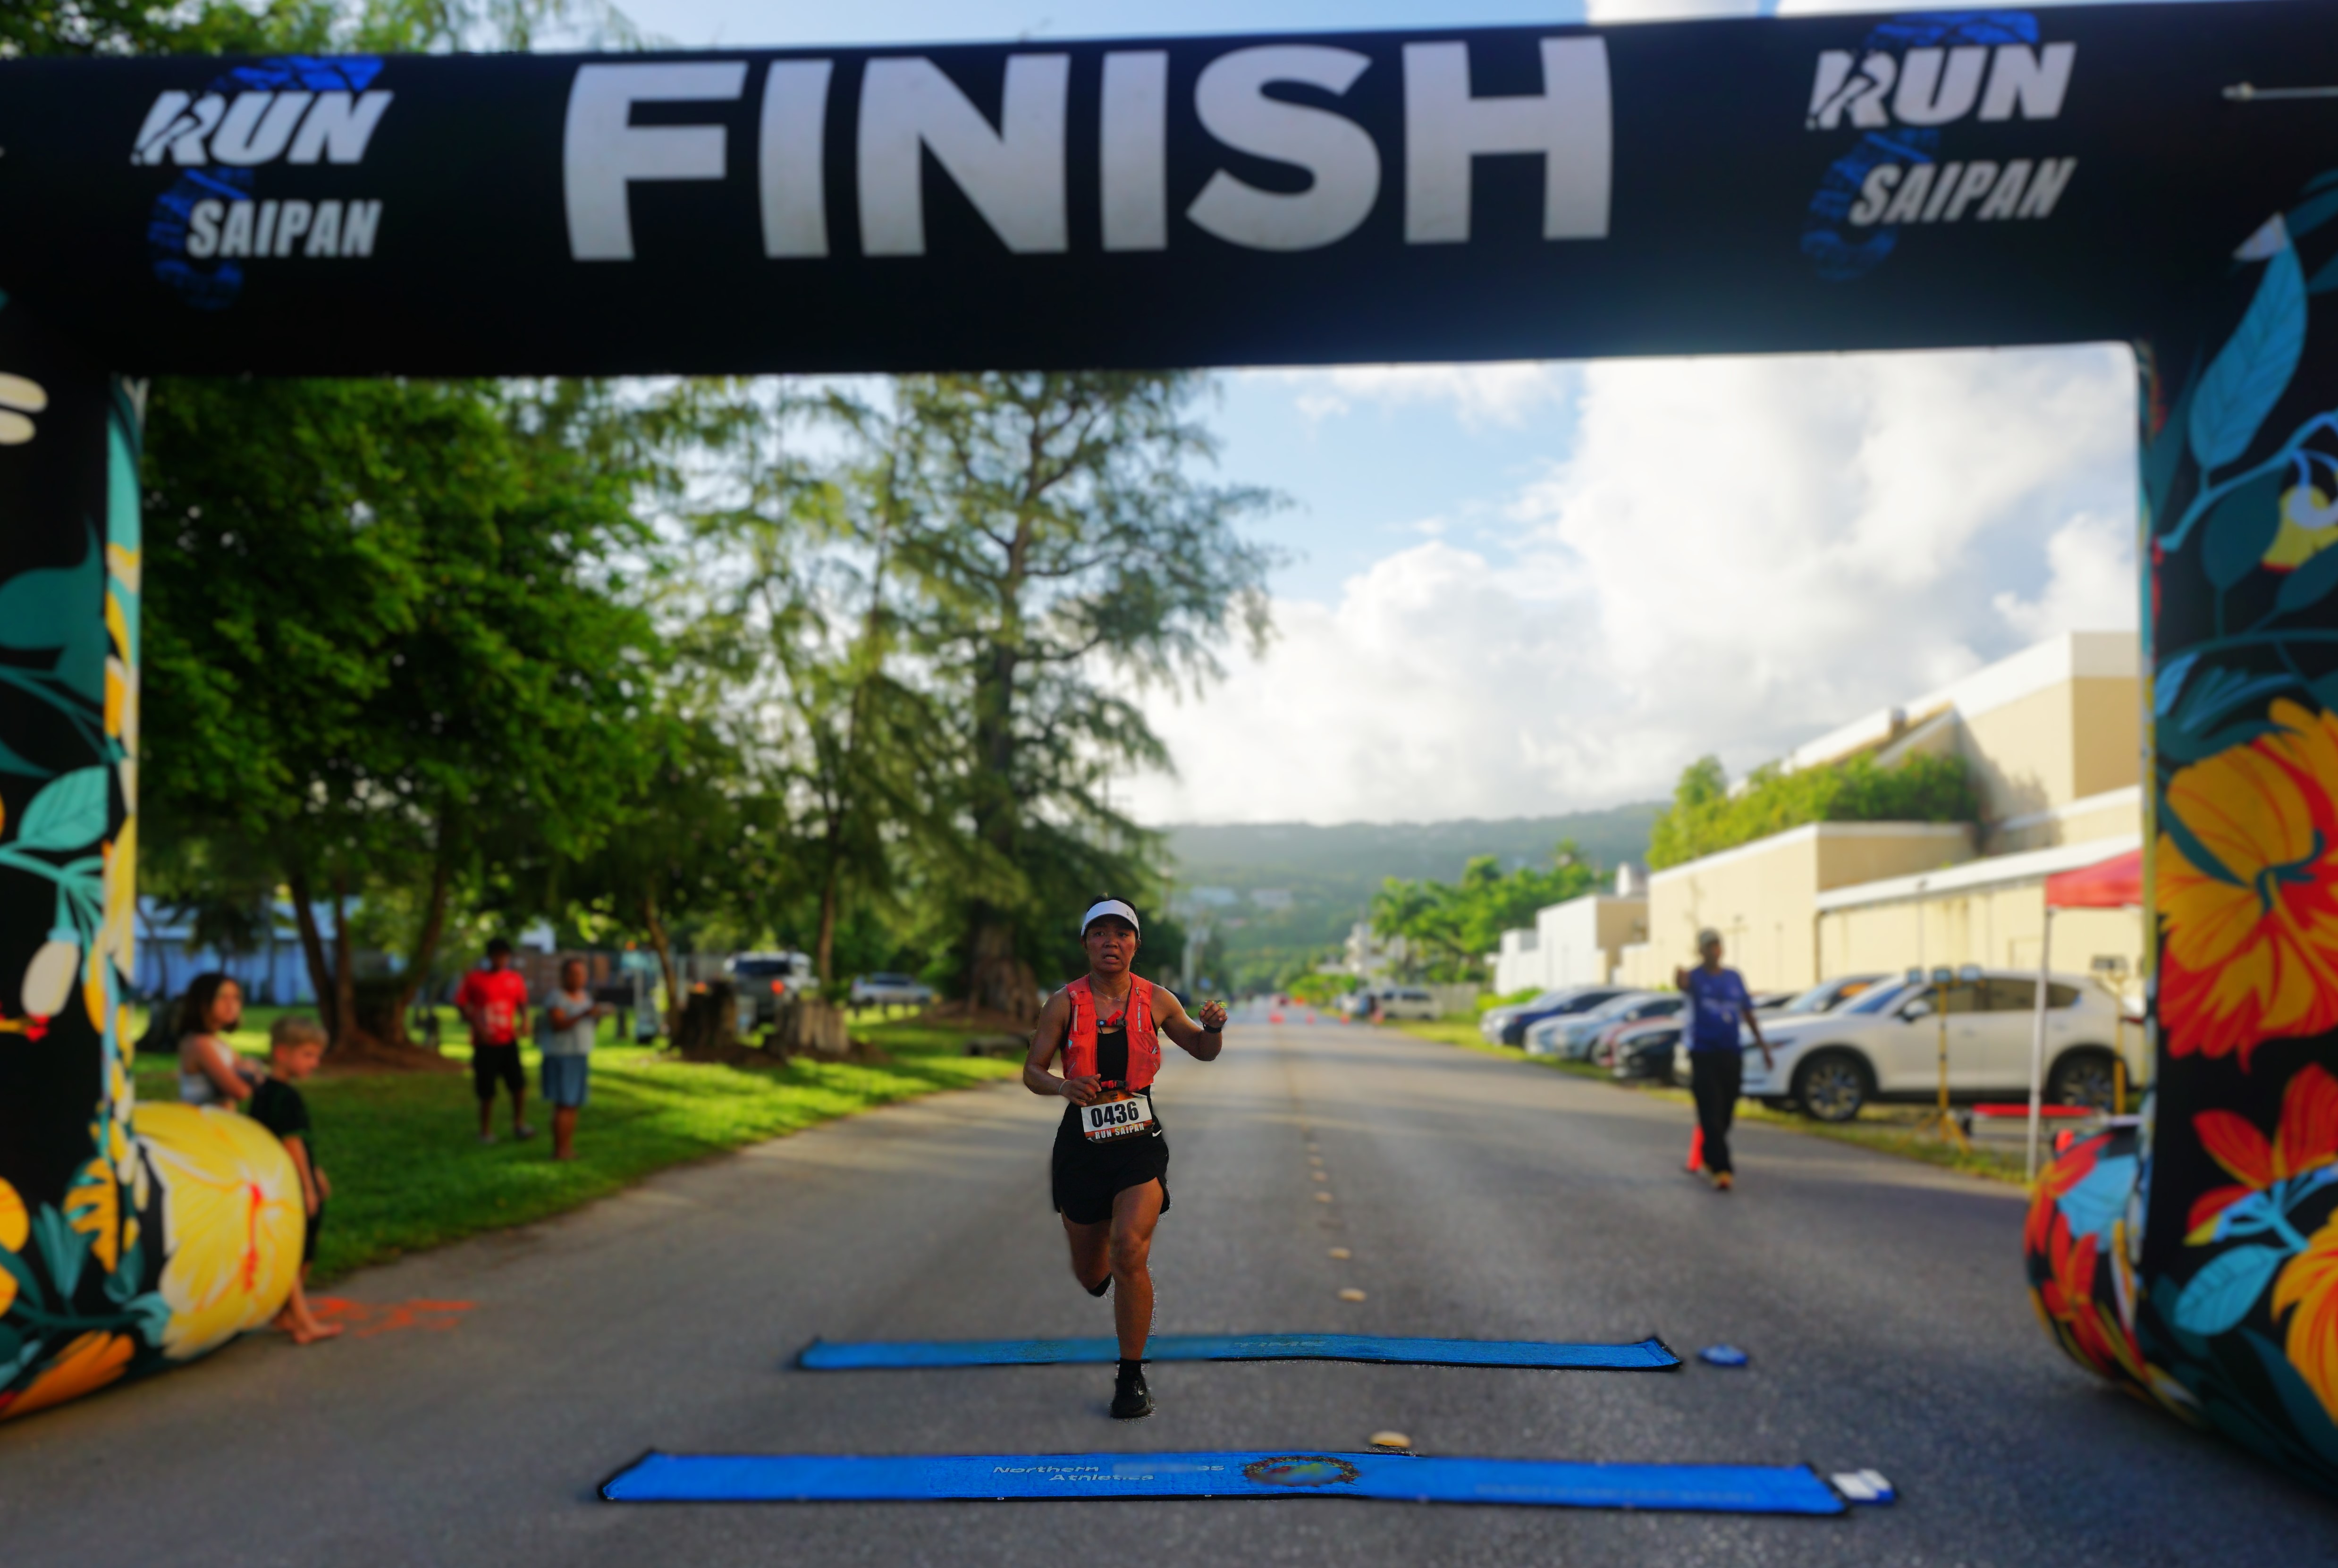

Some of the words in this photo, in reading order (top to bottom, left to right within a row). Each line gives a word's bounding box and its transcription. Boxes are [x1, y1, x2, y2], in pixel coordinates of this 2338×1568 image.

[1806, 42, 2077, 130] RUN
[130, 89, 394, 167] RUN
[562, 35, 1612, 261] FINISH
[1848, 157, 2078, 227] SAIPAN
[186, 198, 383, 259] SAIPAN
[1090, 1101, 1139, 1128] 0436
[1095, 1130, 1112, 1139] RUN
[1114, 1122, 1145, 1136] SAIPAN
